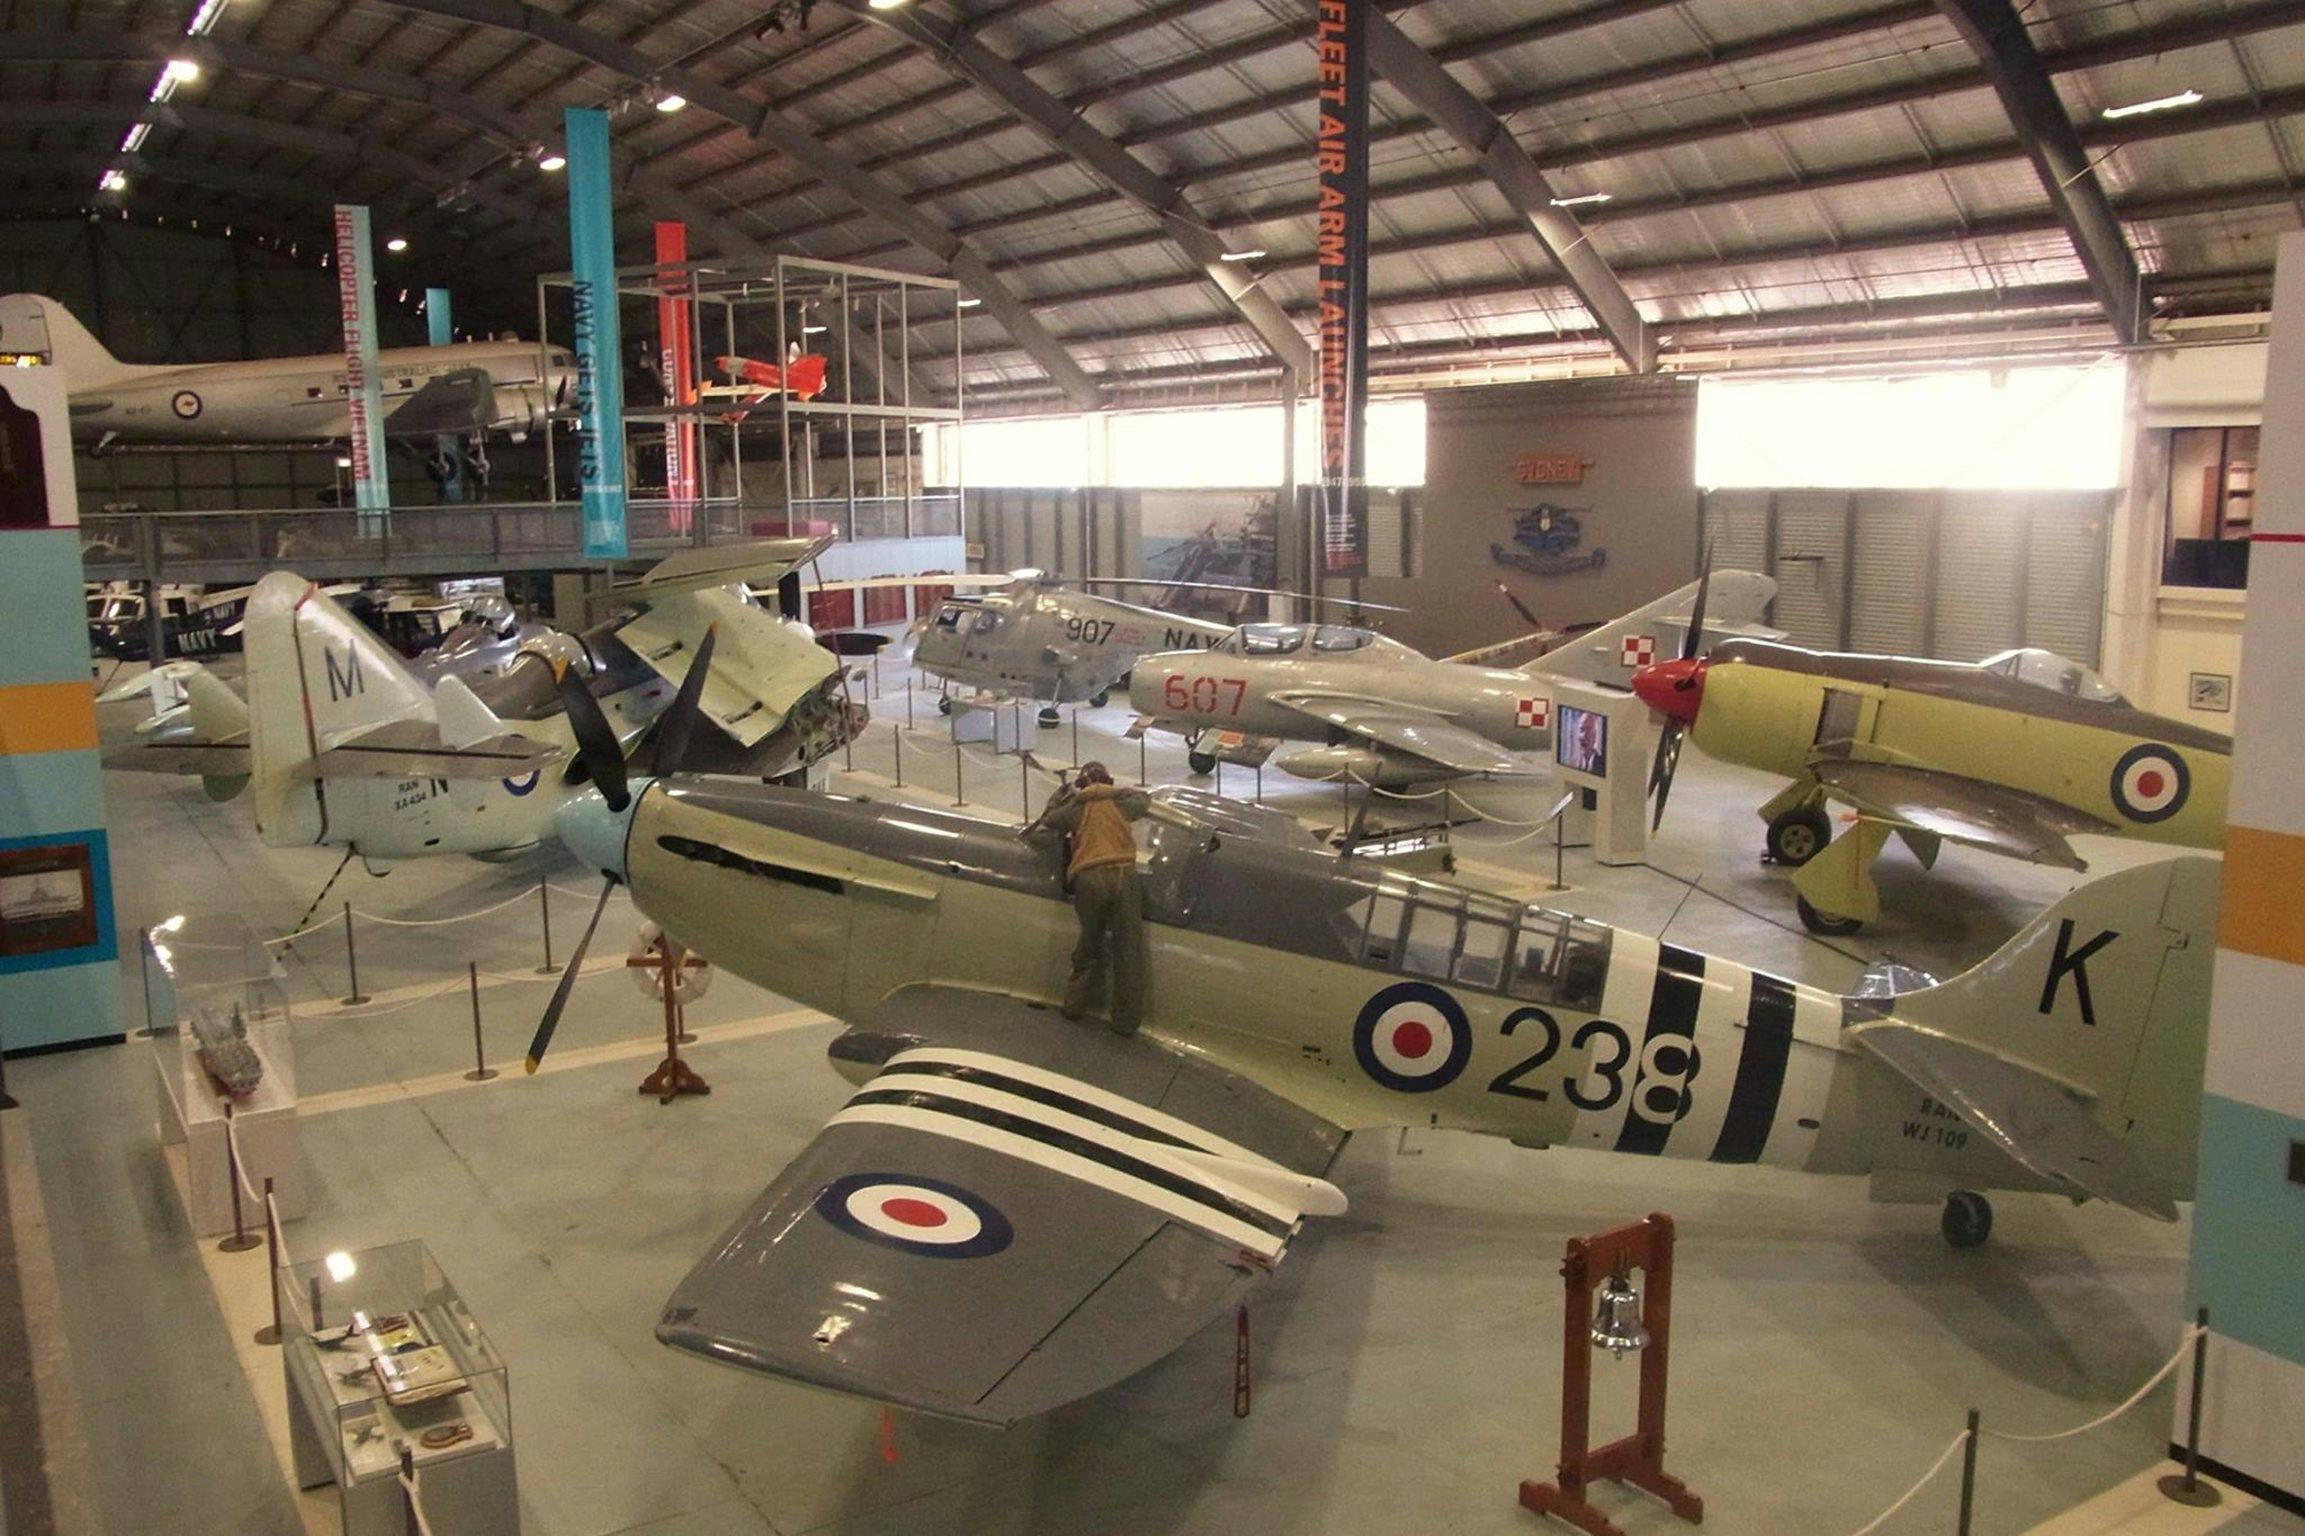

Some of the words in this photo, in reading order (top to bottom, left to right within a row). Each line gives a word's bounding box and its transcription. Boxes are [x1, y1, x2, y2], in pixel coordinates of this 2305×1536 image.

[1319, 0, 1347, 106] FLEET
[1319, 114, 1346, 174] AIR
[1319, 186, 1346, 266] ARM
[335, 212, 359, 322] HELICOPTER
[574, 280, 594, 343] NAVY
[343, 328, 365, 389] FLIGHT
[577, 352, 595, 416] GETS
[1317, 280, 1346, 467] LAUNCHES
[349, 399, 370, 480] VIETNAM
[579, 427, 598, 481] JETS
[177, 627, 216, 653] NAVY
[1066, 617, 1115, 645] 907
[325, 638, 364, 702] M
[1164, 674, 1247, 716] 607
[2038, 918, 2119, 1027] K
[1487, 1006, 1701, 1125] 238
